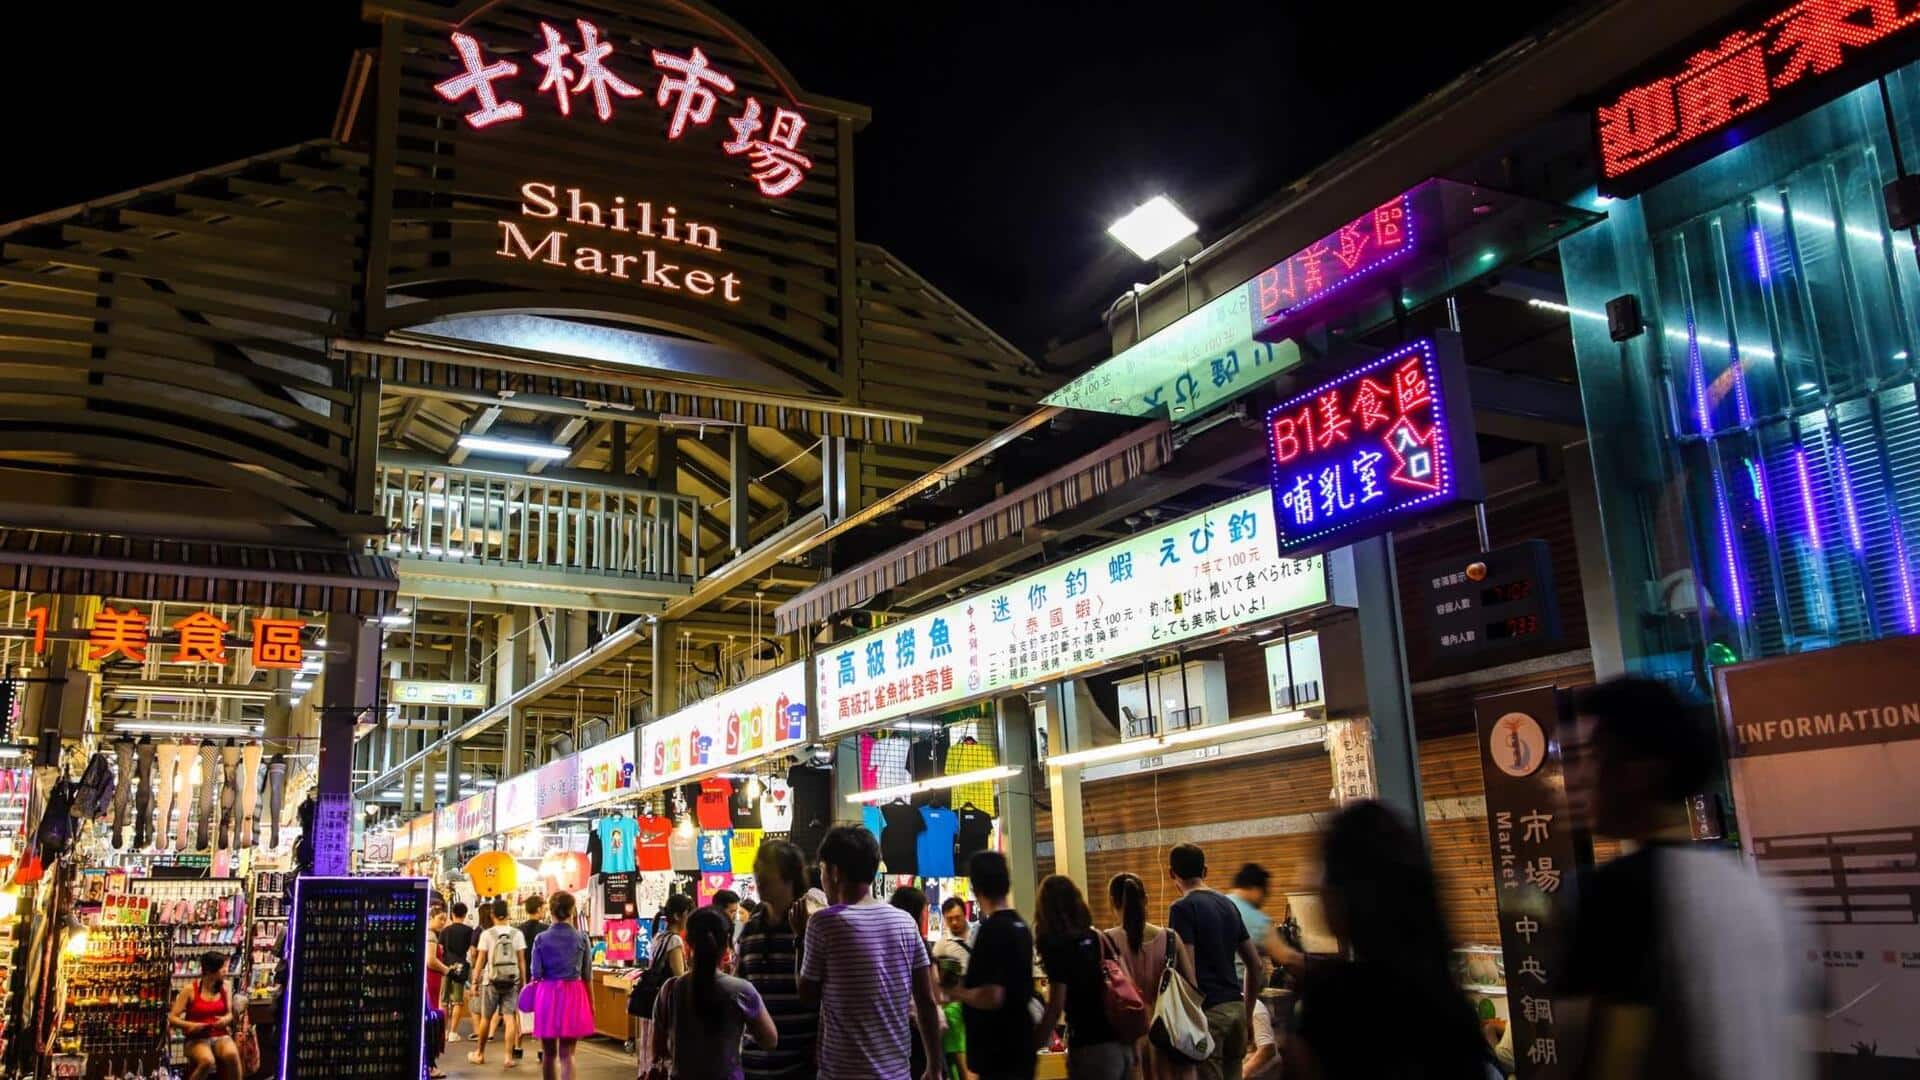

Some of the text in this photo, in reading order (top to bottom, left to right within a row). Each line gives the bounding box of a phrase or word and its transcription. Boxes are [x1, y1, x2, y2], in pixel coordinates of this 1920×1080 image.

[434, 18, 812, 197] 士林市場
[521, 182, 722, 252] Shilin
[496, 220, 741, 302] Market
[1273, 356, 1432, 462] B1美食區
[1282, 449, 1384, 525] 哺乳室
[991, 551, 1134, 624] 迷你釣蝦
[836, 617, 953, 689] 高級撈魚
[838, 665, 954, 720] 高級孔雀魚批發零售
[1736, 703, 1920, 744] INFORMATION
[1495, 811, 1518, 889] Market
[1519, 809, 1561, 893] 市場
